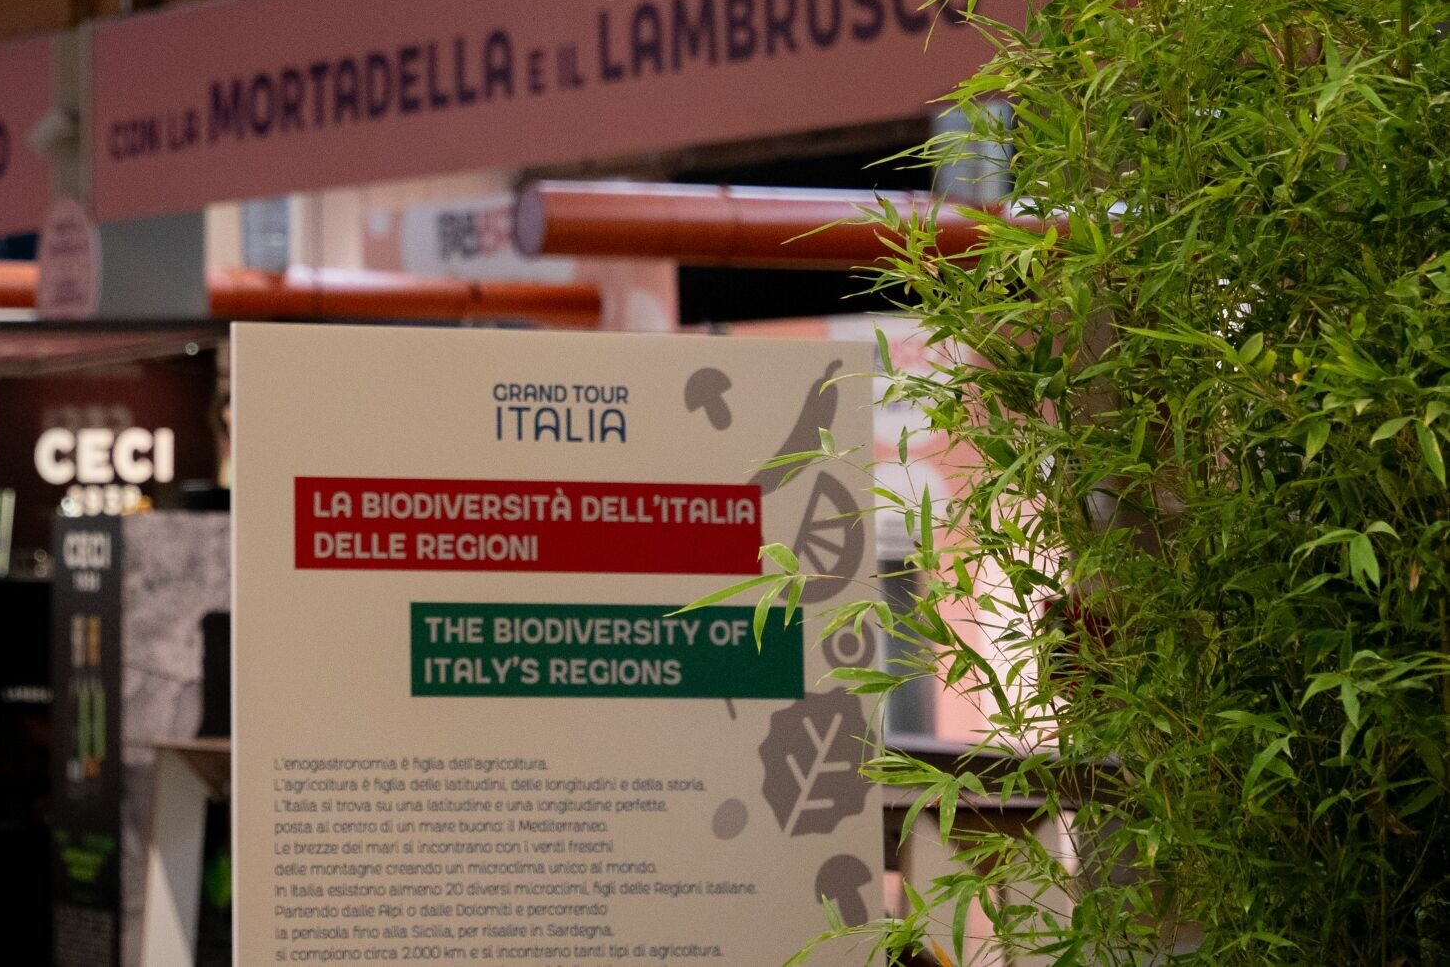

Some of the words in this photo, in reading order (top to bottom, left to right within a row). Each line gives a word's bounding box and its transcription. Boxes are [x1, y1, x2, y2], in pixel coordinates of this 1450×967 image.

[110, 114, 158, 161] CON
[164, 108, 199, 148] LA
[207, 26, 516, 146] MORTADELLA
[526, 51, 548, 97] E
[556, 44, 585, 91] IL
[492, 383, 567, 403] GRAND
[572, 384, 630, 405] TOUR
[495, 405, 627, 444] ITALIA
[34, 426, 175, 485] CECI
[312, 491, 352, 520] LA
[361, 488, 574, 523] BIODIVERSITÀ
[580, 495, 756, 526] DELL'ITALIA
[312, 533, 407, 560] DELLE
[416, 534, 539, 563] REGIONI
[423, 616, 484, 644] THE
[494, 616, 702, 647] BIODIVERSITY
[708, 618, 750, 647] OF
[423, 656, 540, 687] ITALY'S
[548, 657, 683, 687] REGIONS
